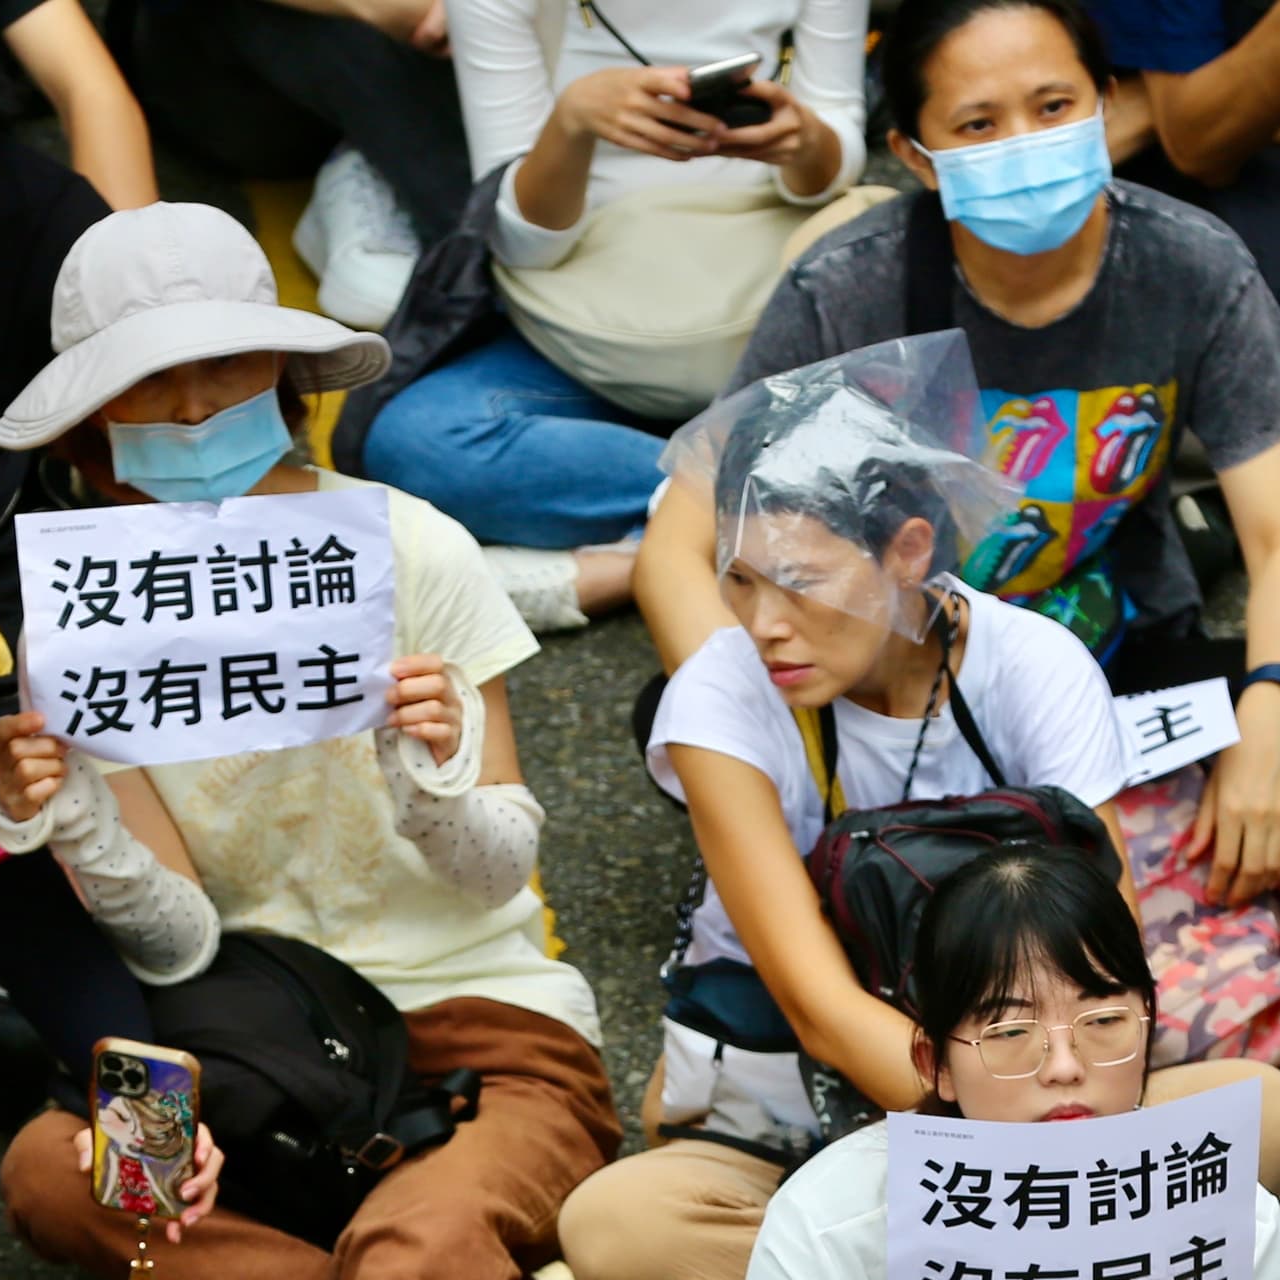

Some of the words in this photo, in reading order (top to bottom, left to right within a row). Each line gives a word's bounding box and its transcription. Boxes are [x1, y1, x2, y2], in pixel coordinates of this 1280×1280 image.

[51, 534, 357, 630] 沒有討論
[60, 644, 365, 737] 沒有民主
[920, 1131, 1232, 1231] 沒有討論
